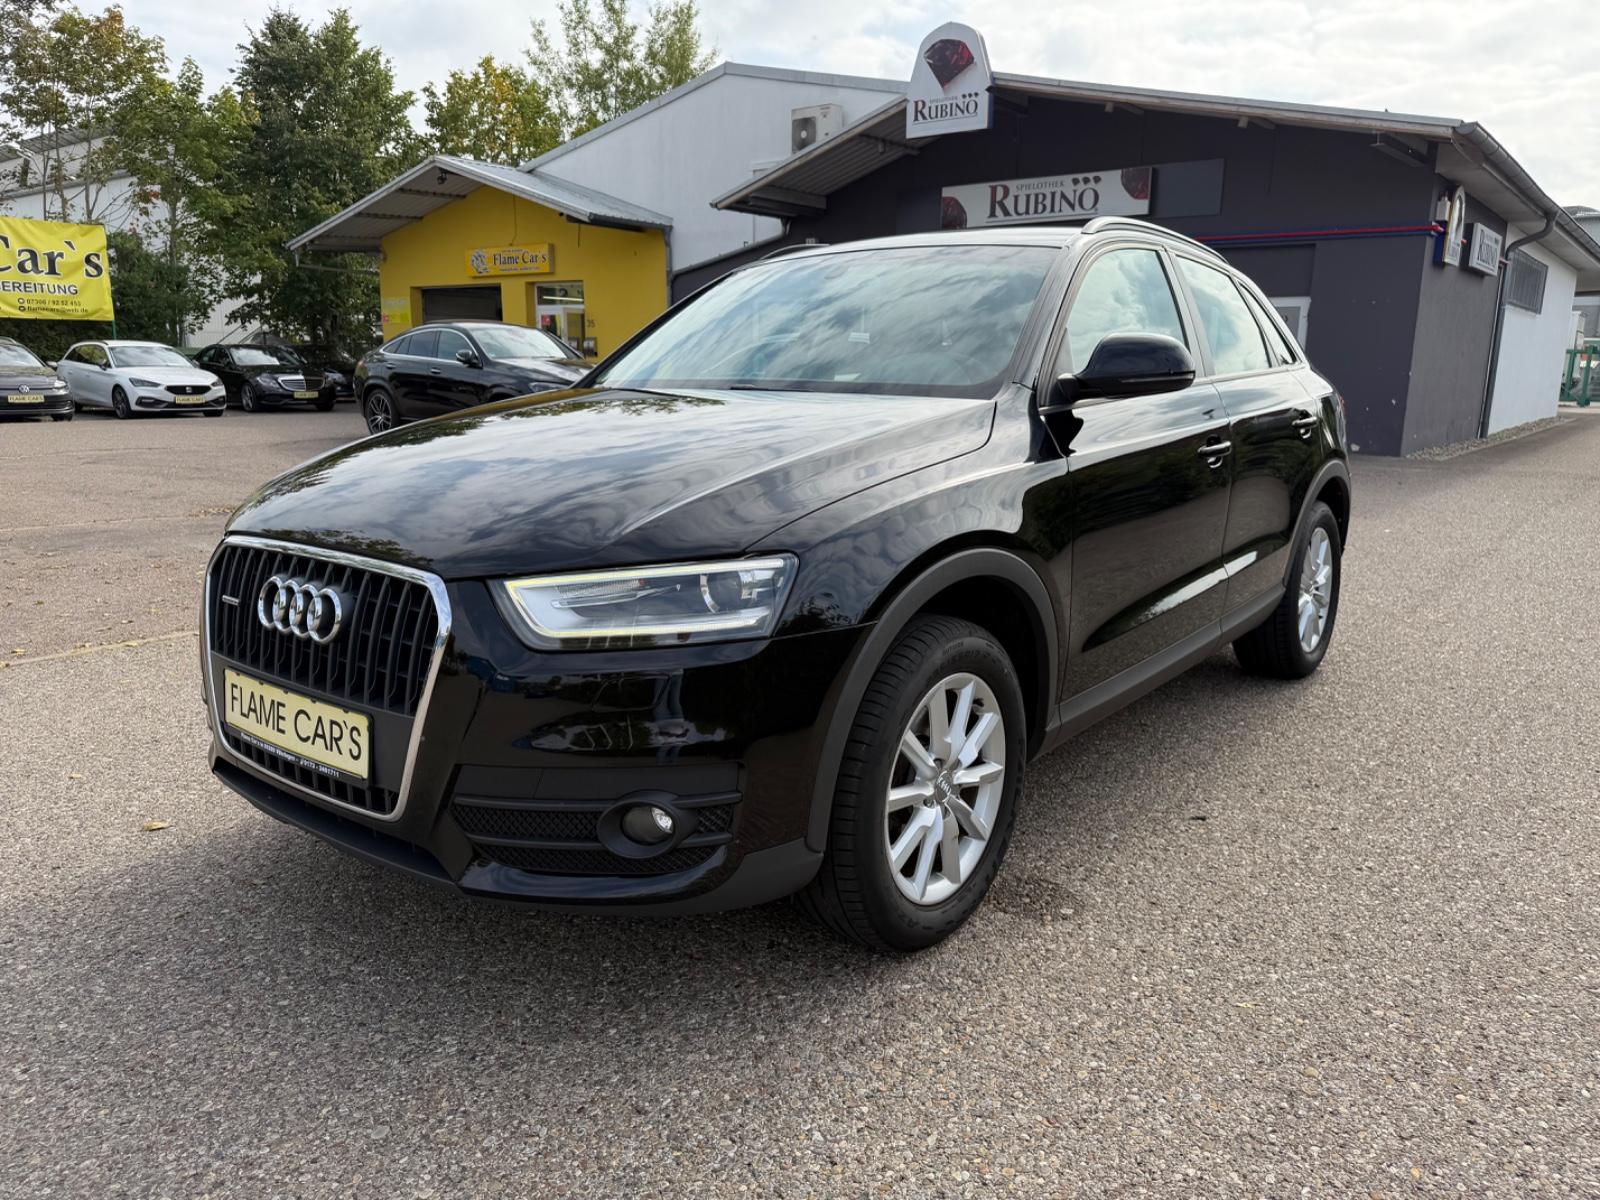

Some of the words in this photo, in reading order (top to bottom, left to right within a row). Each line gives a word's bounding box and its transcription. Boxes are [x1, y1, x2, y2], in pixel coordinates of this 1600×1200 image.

[913, 99, 978, 122] RUBINO
[1016, 180, 1064, 192] SPIELOTHEK
[987, 184, 1099, 219] RUBINO
[493, 252, 519, 266] Flame
[0, 281, 78, 295] EREITUNG
[230, 683, 286, 735] FLAME
